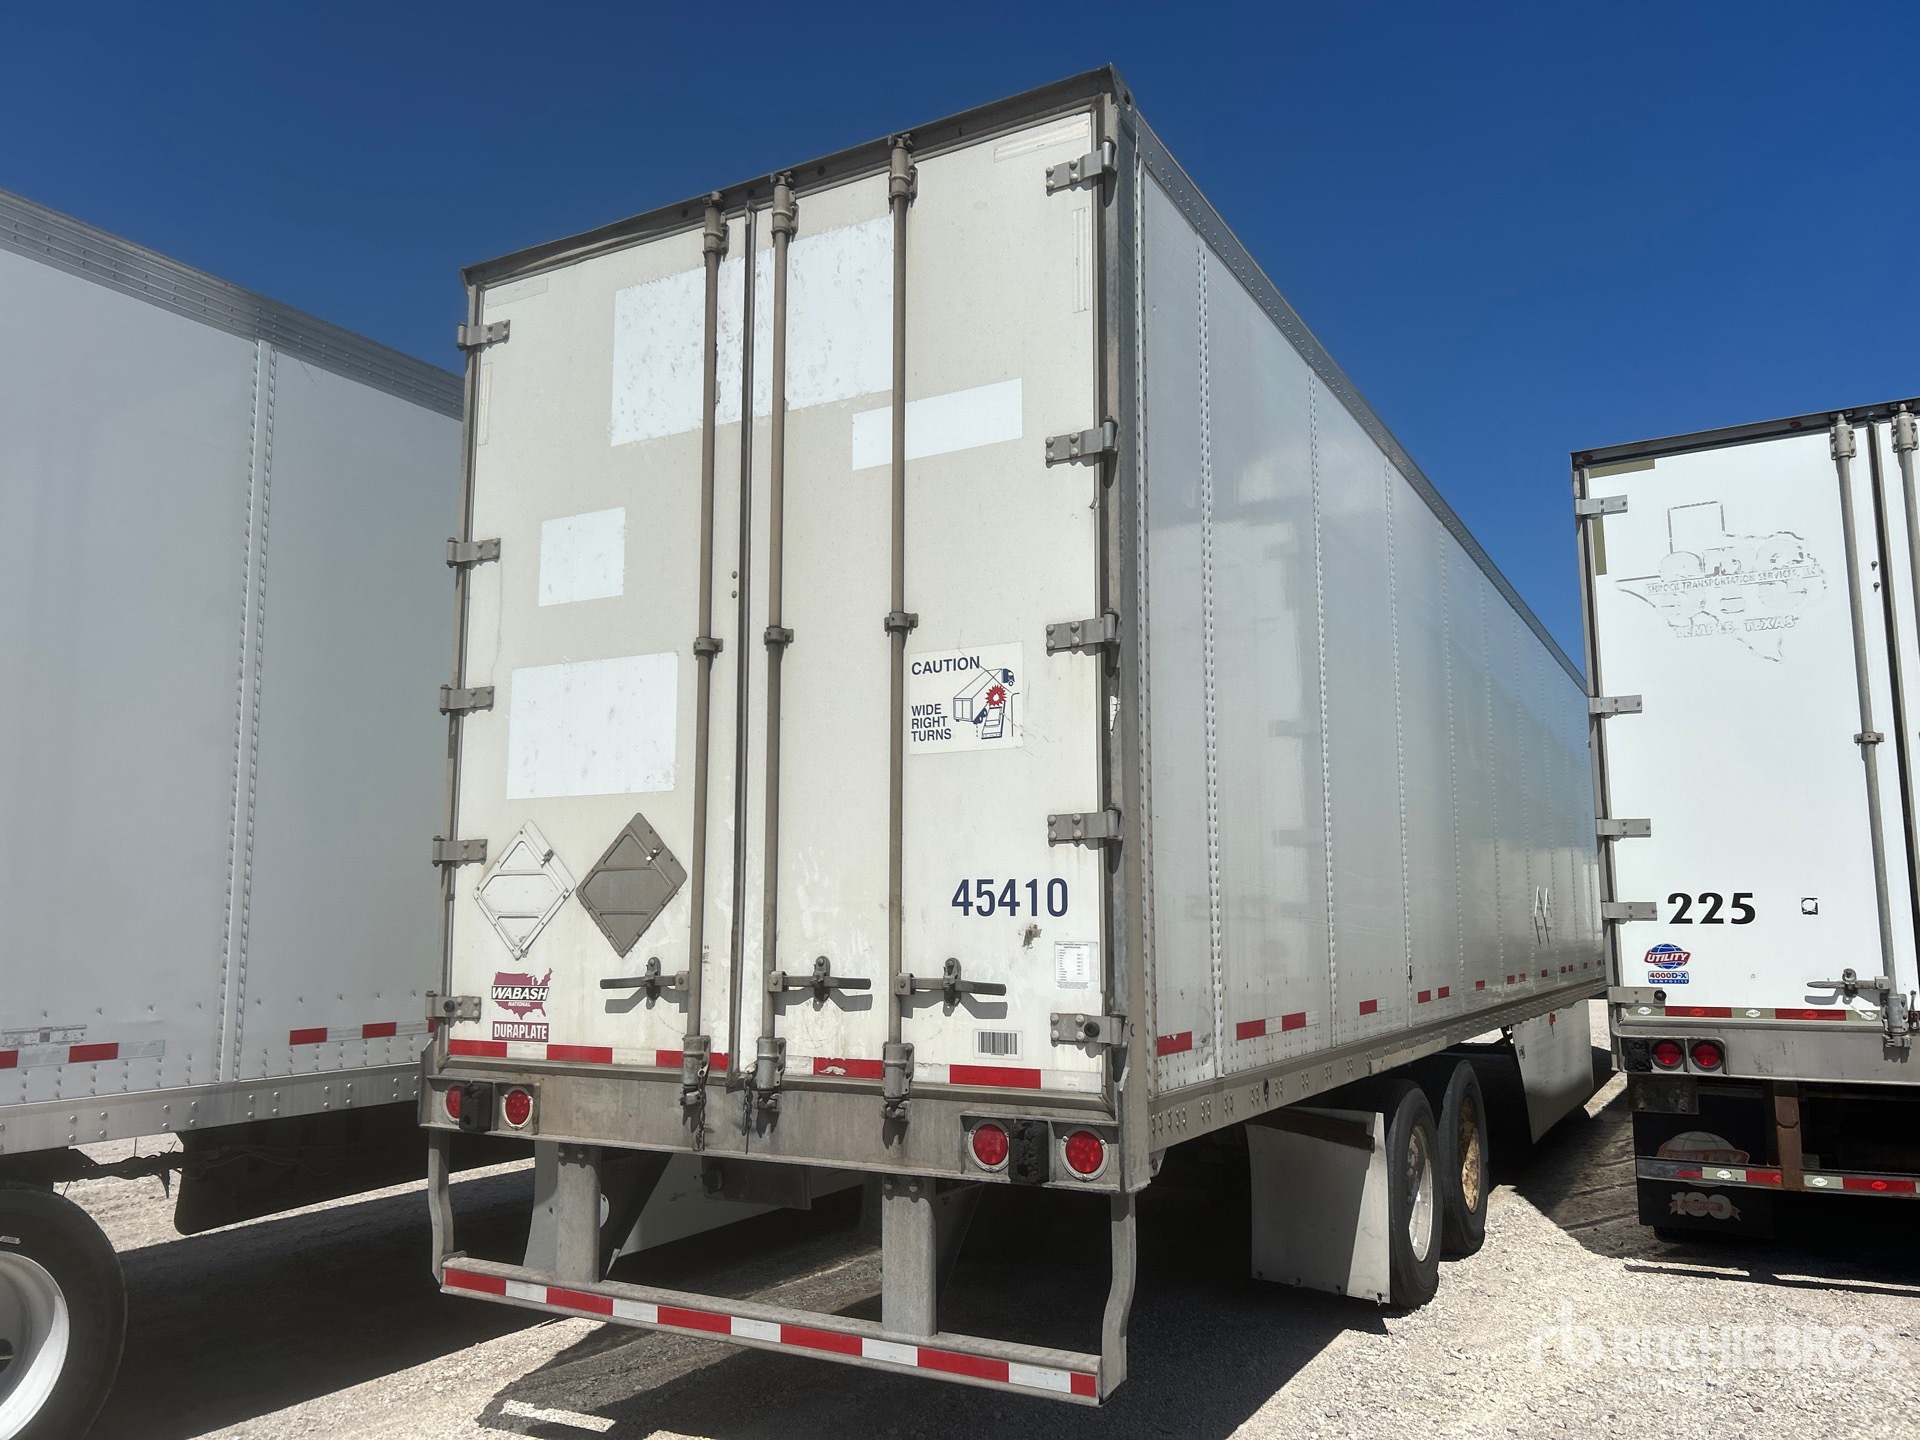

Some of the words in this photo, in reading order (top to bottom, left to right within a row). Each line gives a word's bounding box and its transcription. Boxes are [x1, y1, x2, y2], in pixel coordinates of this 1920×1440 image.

[1743, 615, 1797, 632] TEXAS
[911, 655, 981, 675] CAUTION
[911, 703, 942, 716] WIDE
[911, 716, 949, 729] RIGHT
[911, 728, 952, 742] TURNS
[951, 877, 1068, 917] 45410
[1667, 892, 1756, 924] 225
[1646, 953, 1689, 962] UTILITY
[491, 986, 549, 1001] WABASH
[494, 1023, 548, 1040] DURAPLATE
